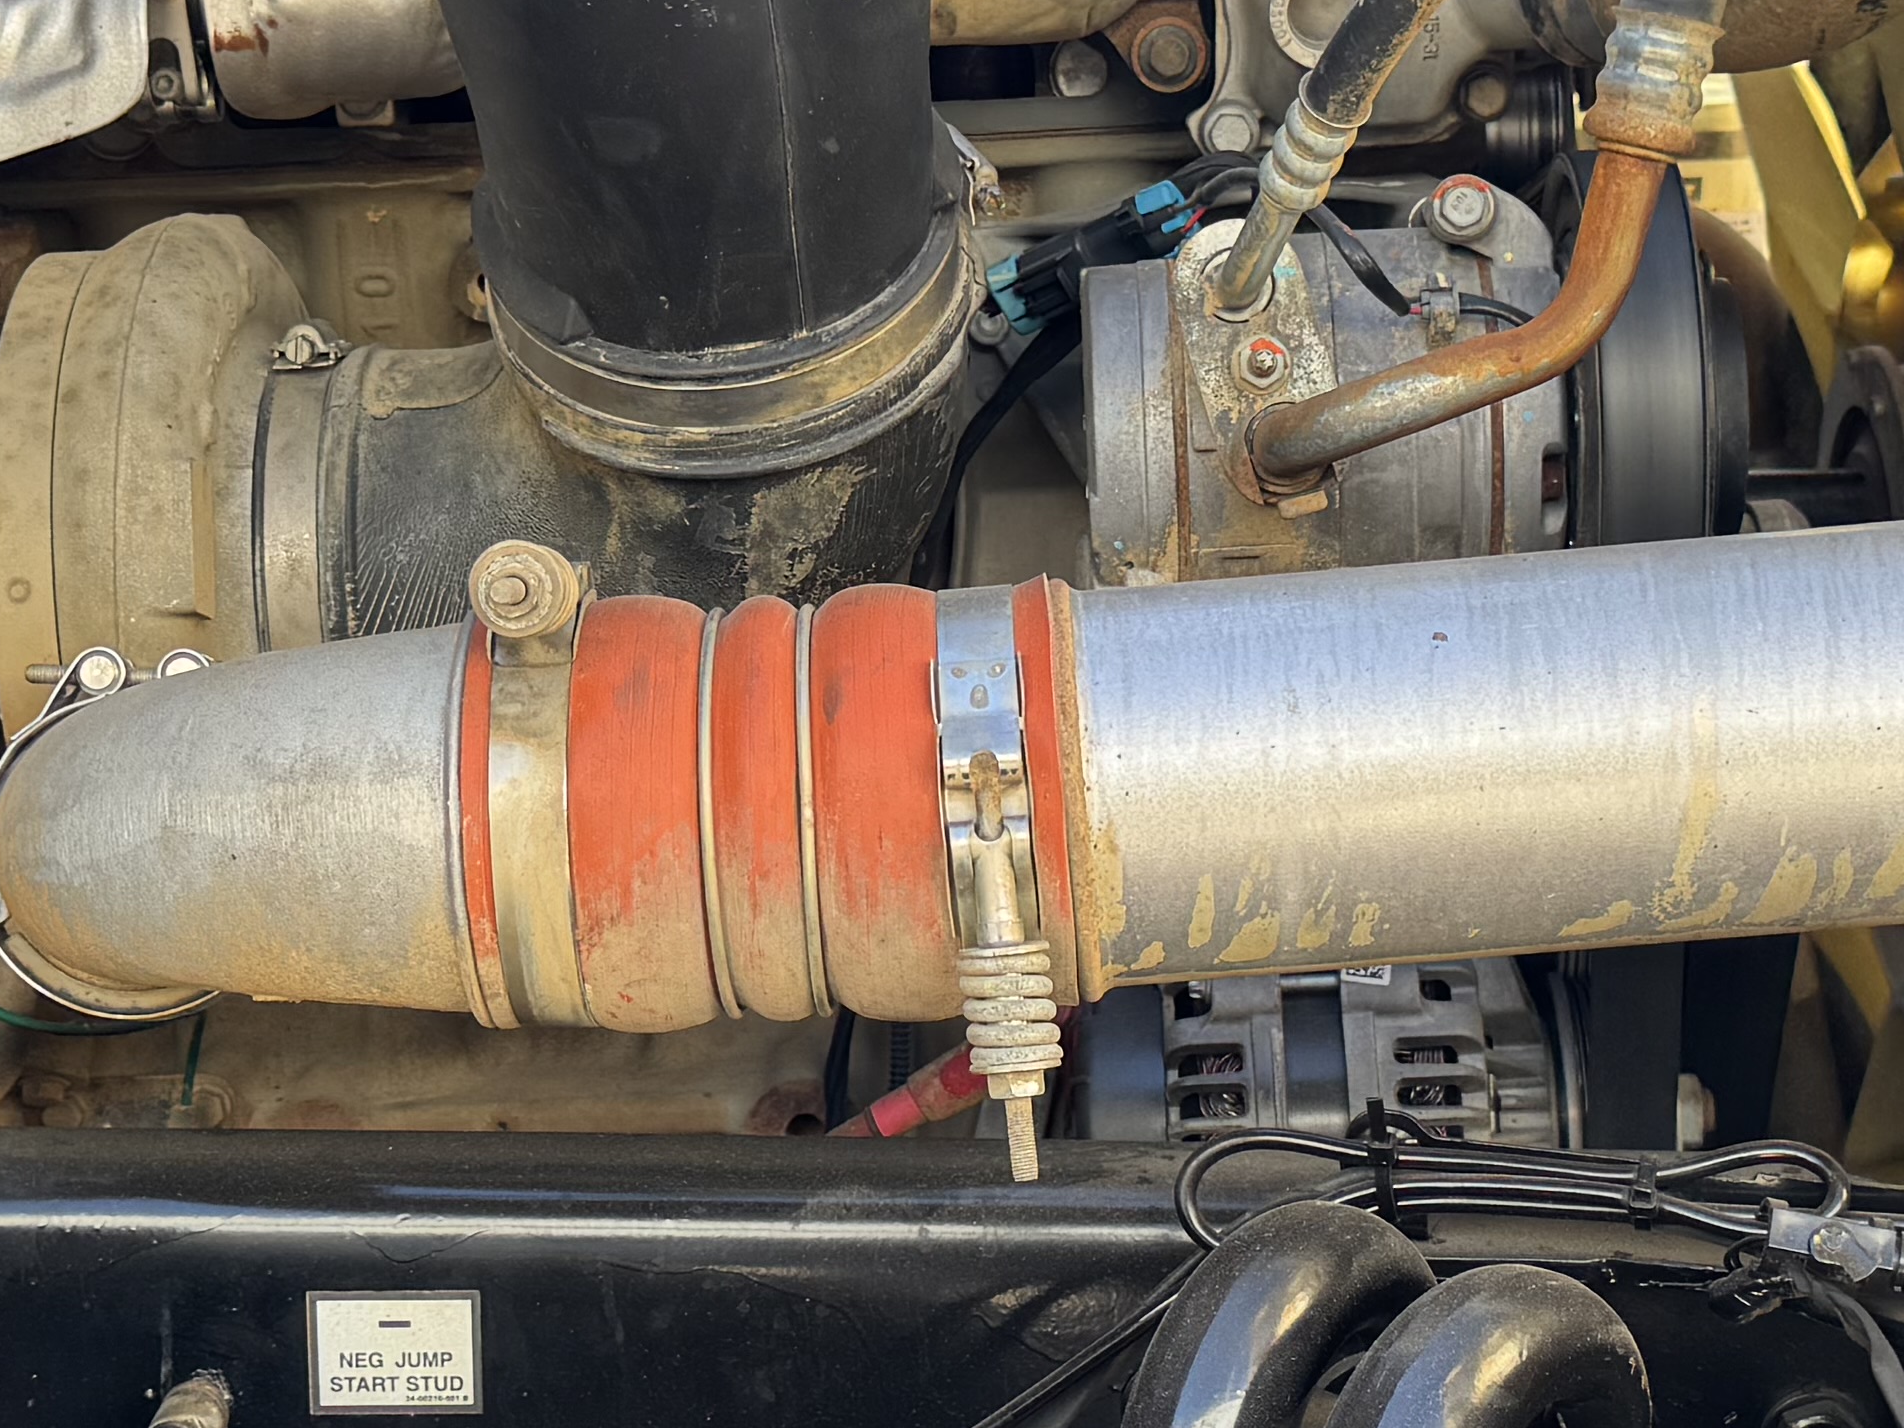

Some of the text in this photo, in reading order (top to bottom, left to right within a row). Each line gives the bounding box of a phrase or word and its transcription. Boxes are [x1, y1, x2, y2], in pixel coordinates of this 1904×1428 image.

[339, 1351, 453, 1369] NEG JUMP
[330, 1375, 464, 1393] START STUD
